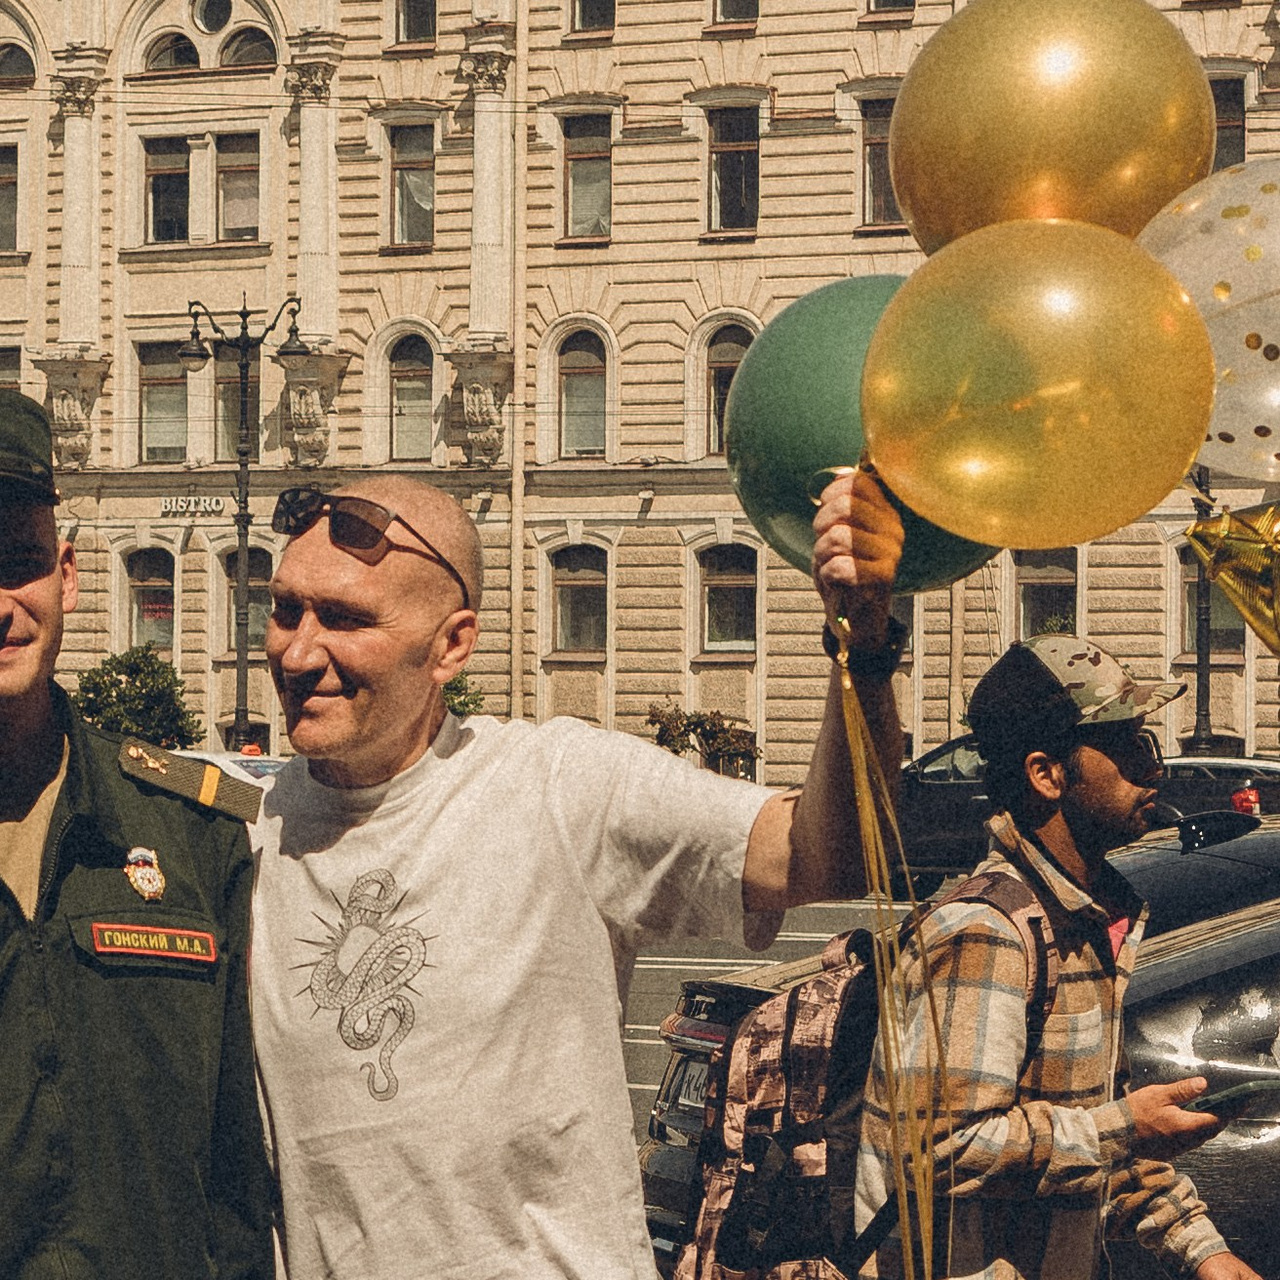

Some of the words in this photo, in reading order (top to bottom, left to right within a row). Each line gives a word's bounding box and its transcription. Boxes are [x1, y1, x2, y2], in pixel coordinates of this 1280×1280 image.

[161, 496, 224, 512] BISTRO
[103, 930, 169, 950] ГОНСКИЙ
[176, 936, 206, 954] М.А.
